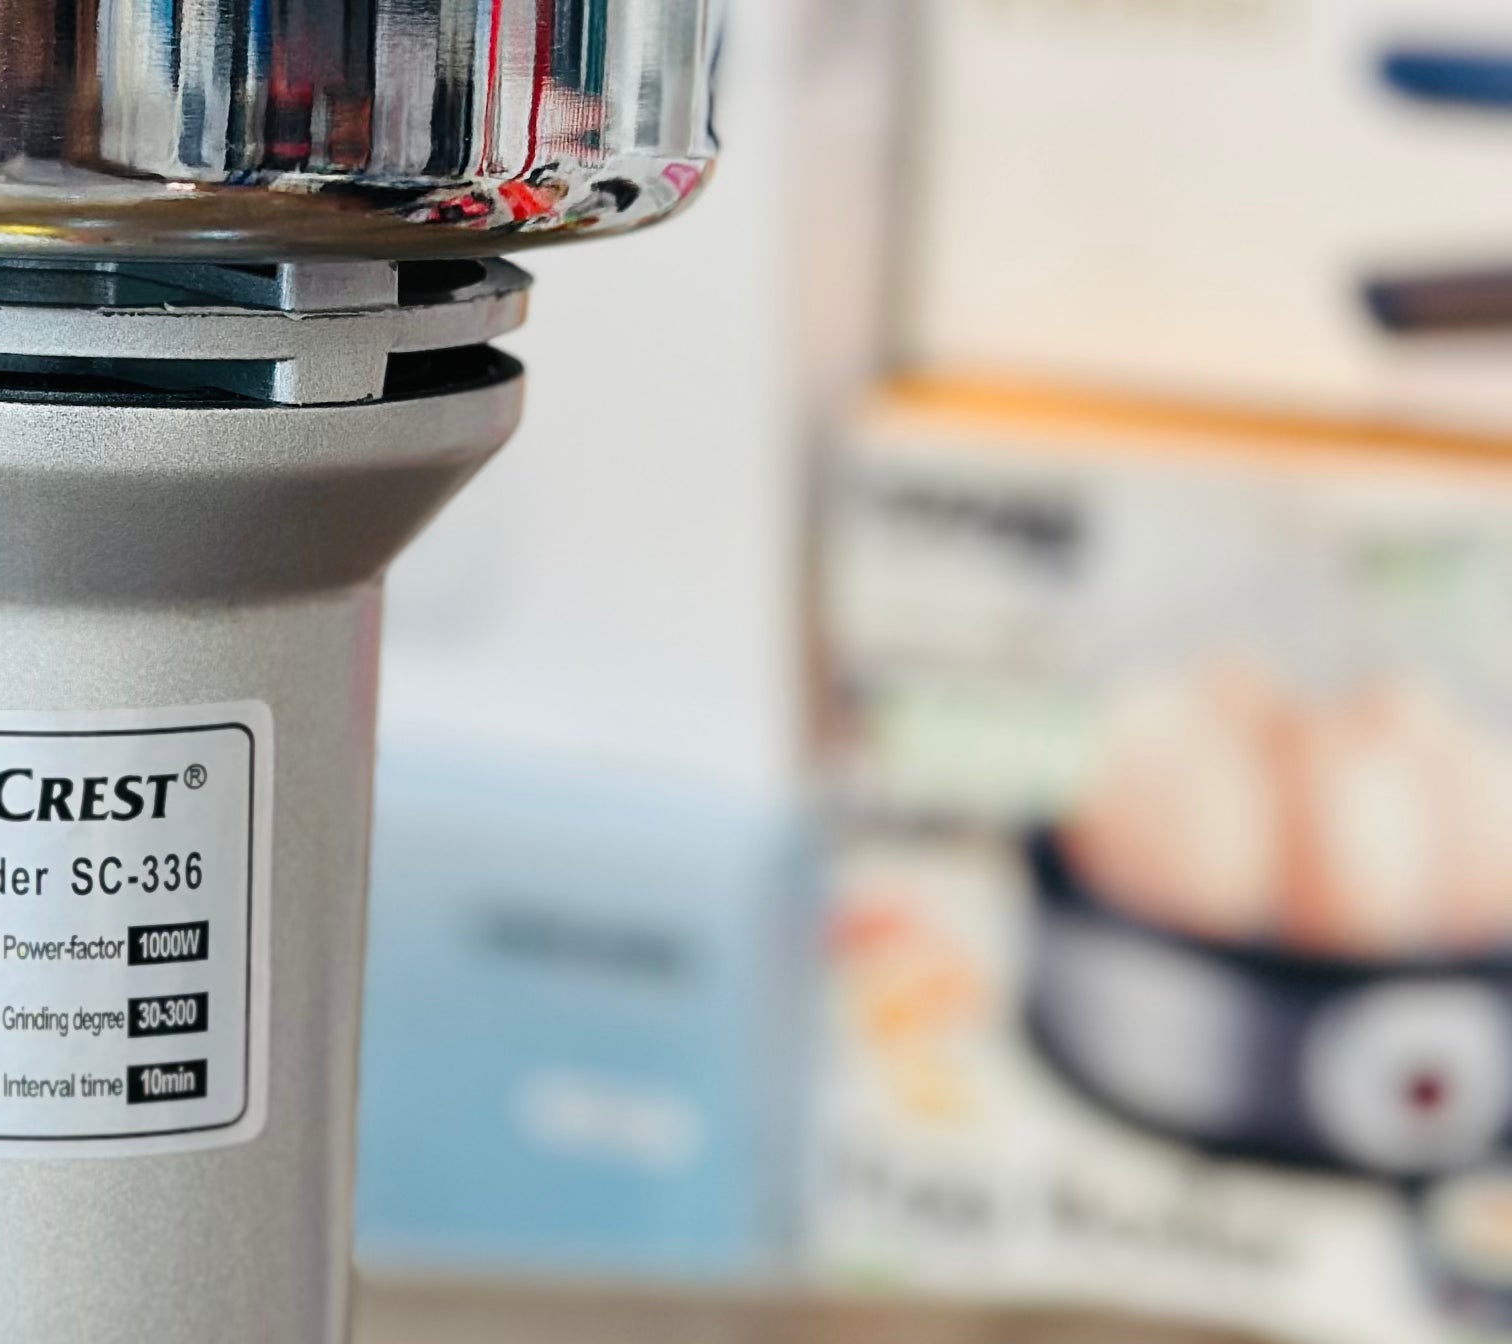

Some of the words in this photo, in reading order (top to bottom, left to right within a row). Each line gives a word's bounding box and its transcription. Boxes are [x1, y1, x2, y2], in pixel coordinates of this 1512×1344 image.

[71, 851, 203, 896] SC-336
[3, 934, 125, 960] Power-factor
[139, 928, 200, 959] 1000W
[2, 1006, 69, 1037] Grinding
[73, 1007, 125, 1037] degree
[138, 998, 197, 1029] 30-300
[3, 1072, 75, 1098] Interval
[80, 1072, 124, 1097] time
[140, 1066, 195, 1096] 10min
